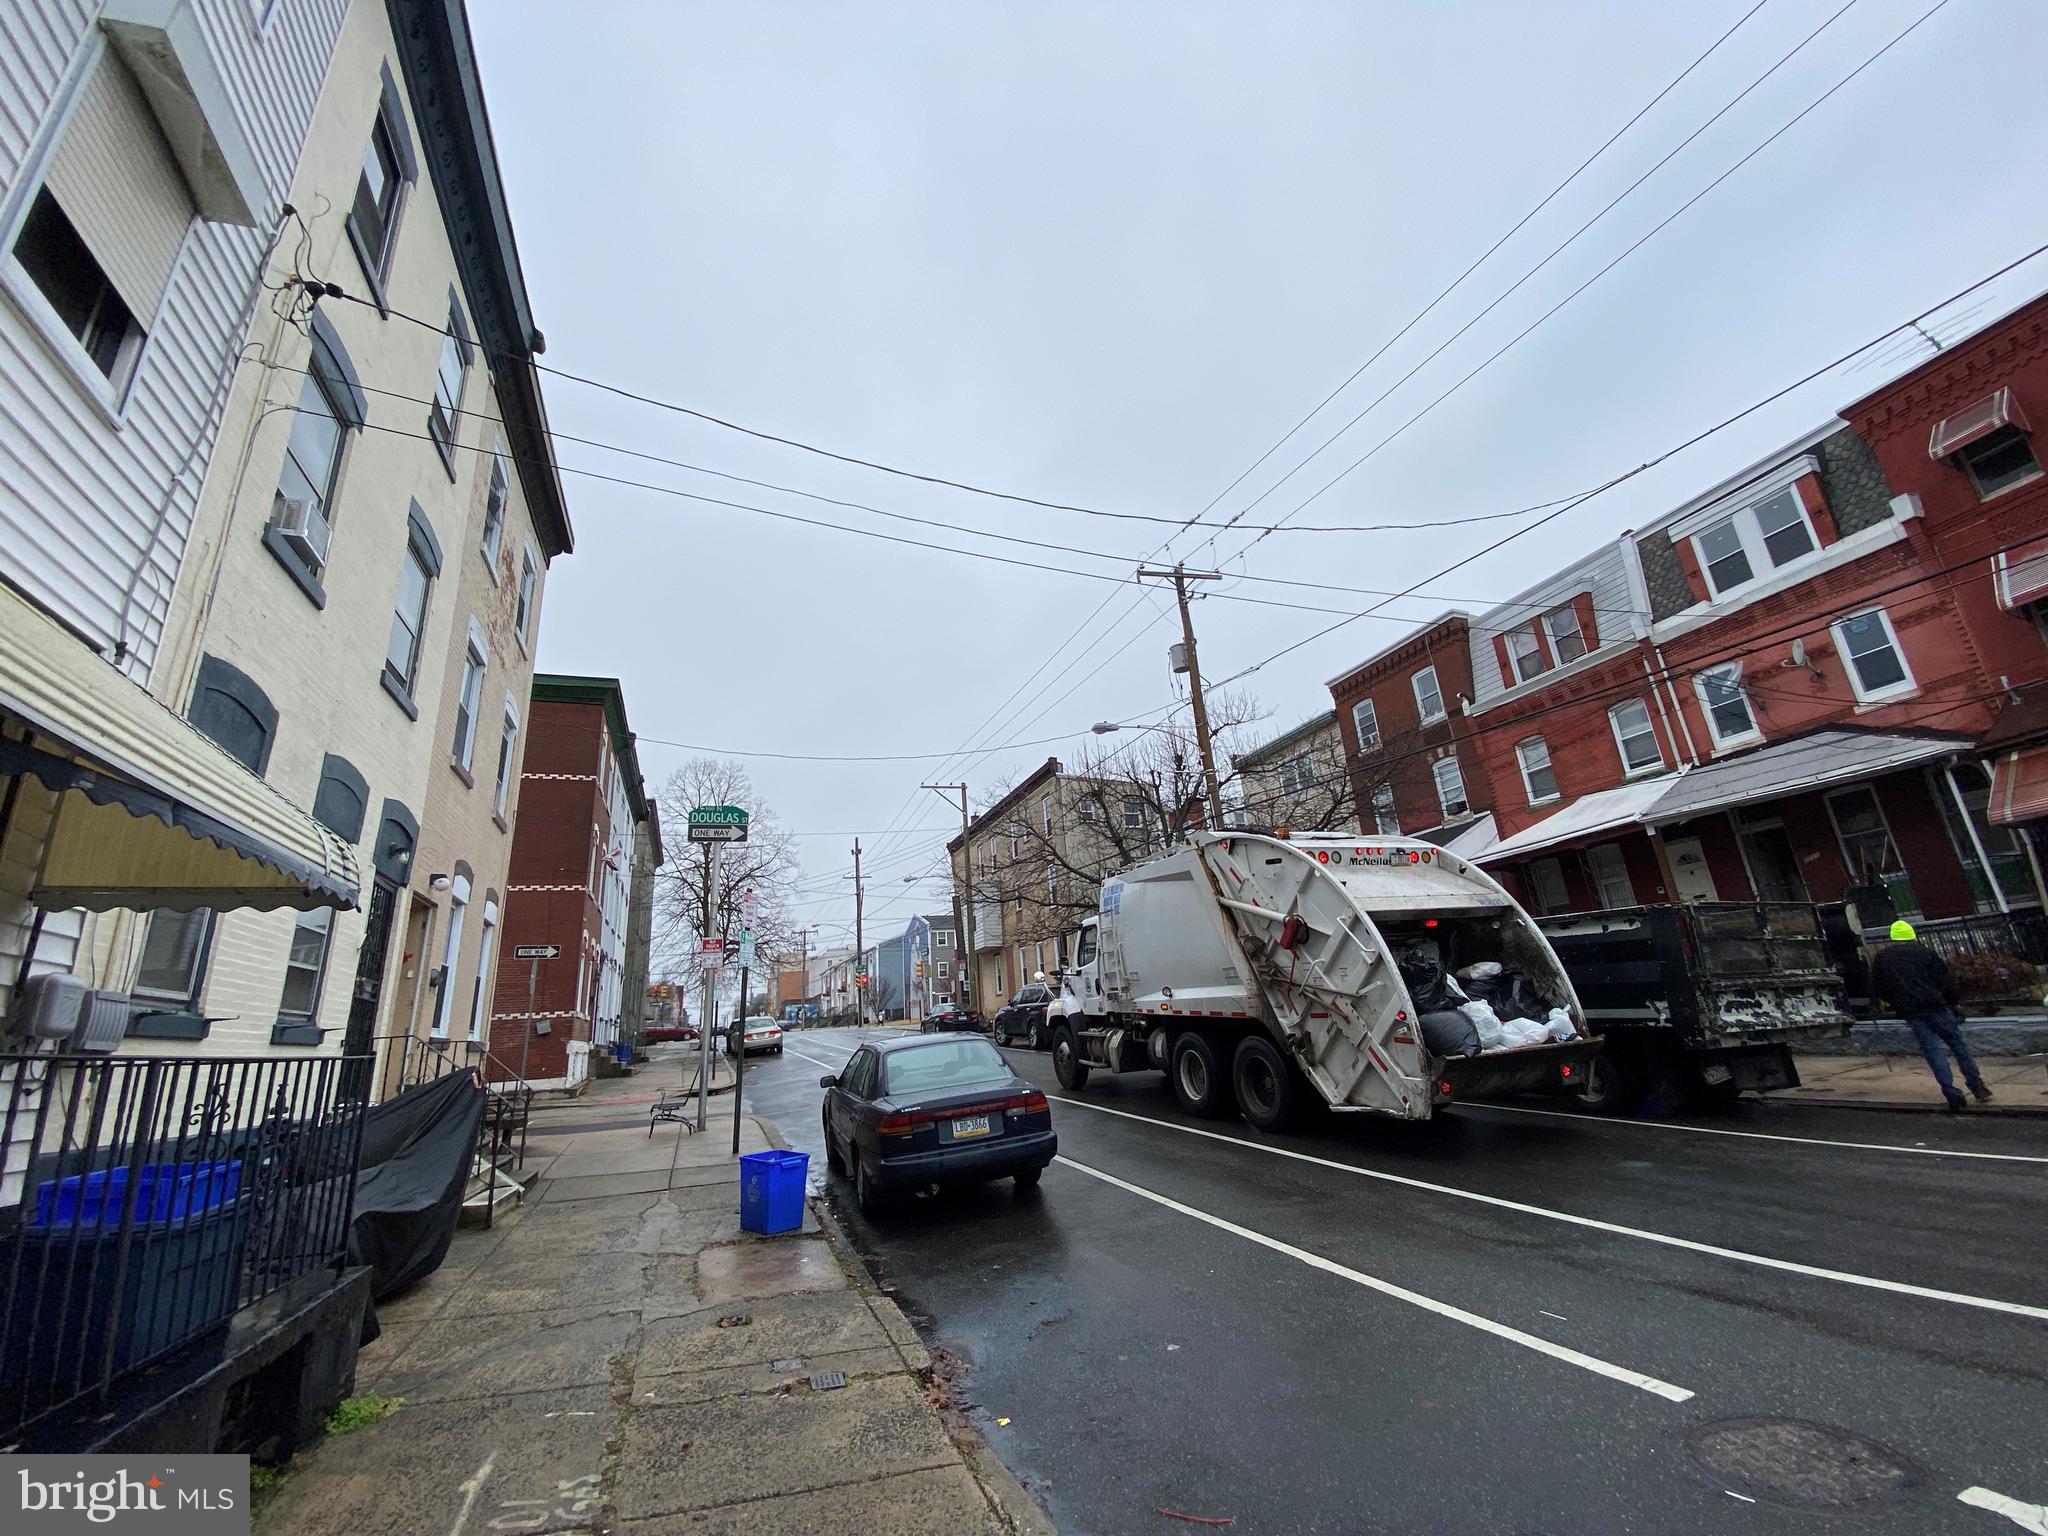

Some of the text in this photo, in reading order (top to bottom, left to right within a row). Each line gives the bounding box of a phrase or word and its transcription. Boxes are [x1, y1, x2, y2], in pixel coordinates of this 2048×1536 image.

[691, 812, 740, 823] DOUGLAS
[694, 829, 730, 837] ONE WAY
